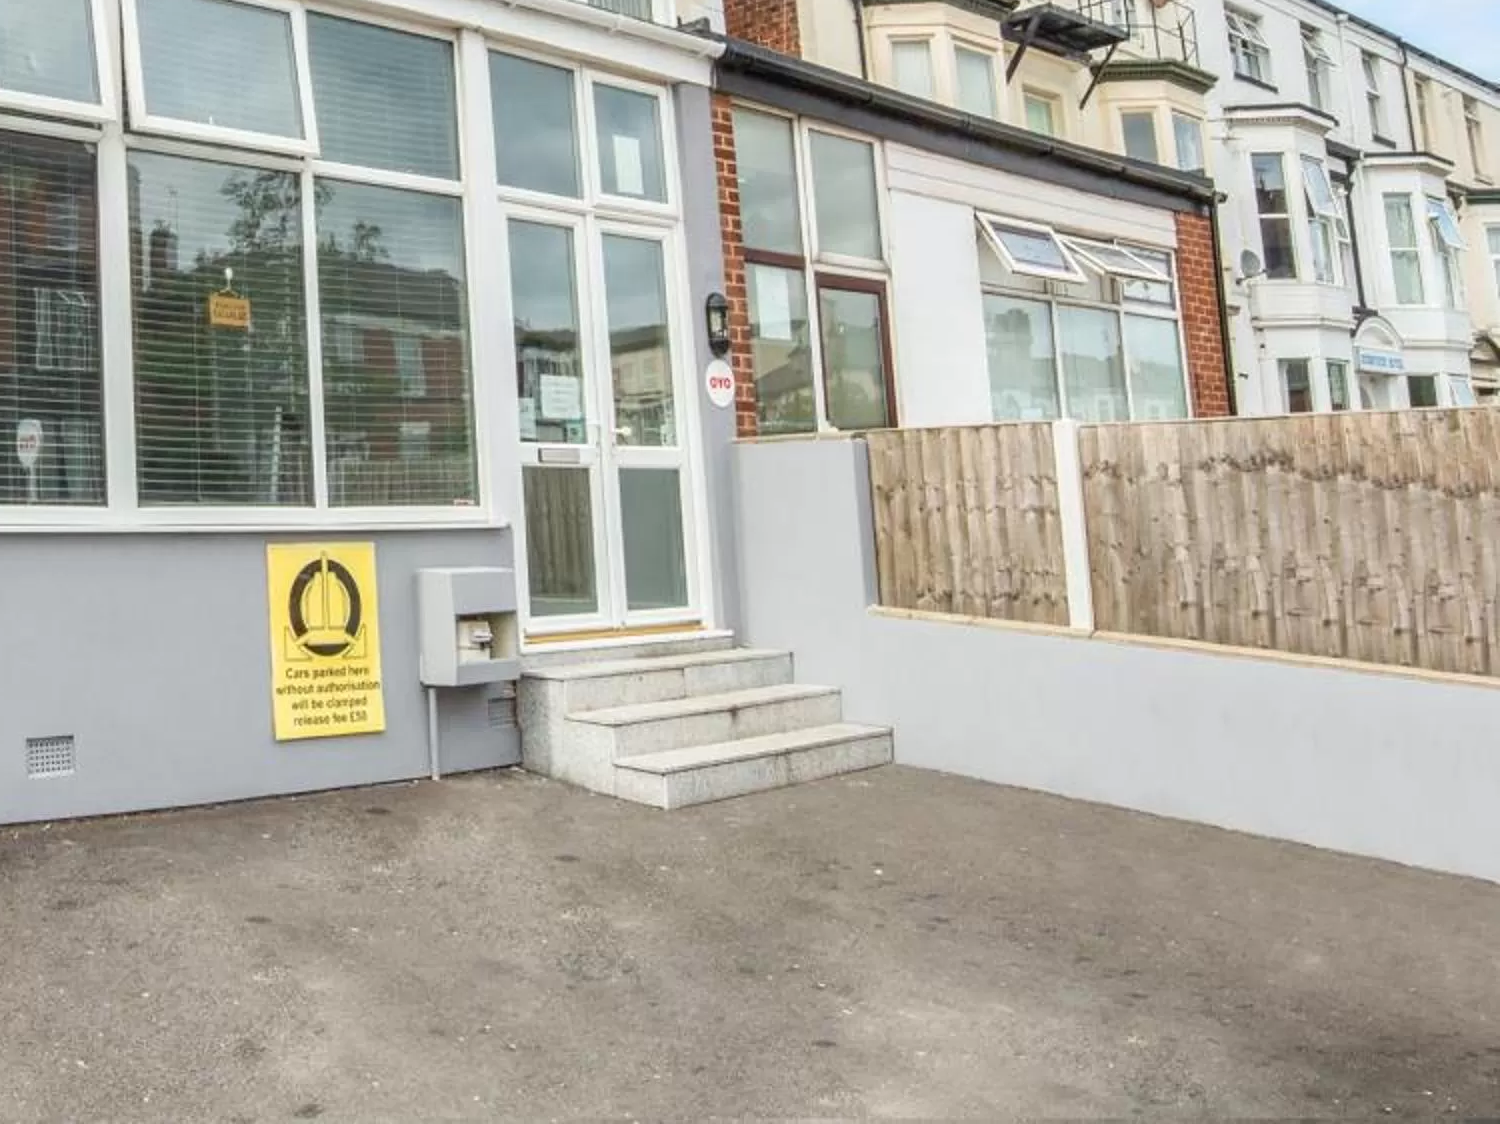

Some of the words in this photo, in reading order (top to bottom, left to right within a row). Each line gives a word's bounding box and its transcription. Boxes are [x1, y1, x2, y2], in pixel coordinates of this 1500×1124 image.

[285, 667, 309, 679] Cars
[312, 665, 346, 679] parked
[348, 664, 369, 676] here
[276, 683, 314, 694] without
[316, 680, 380, 693] authorisation
[292, 699, 308, 710] will
[311, 699, 324, 709] be
[326, 696, 367, 708] clamped
[294, 714, 330, 726] release
[332, 712, 348, 724] fee
